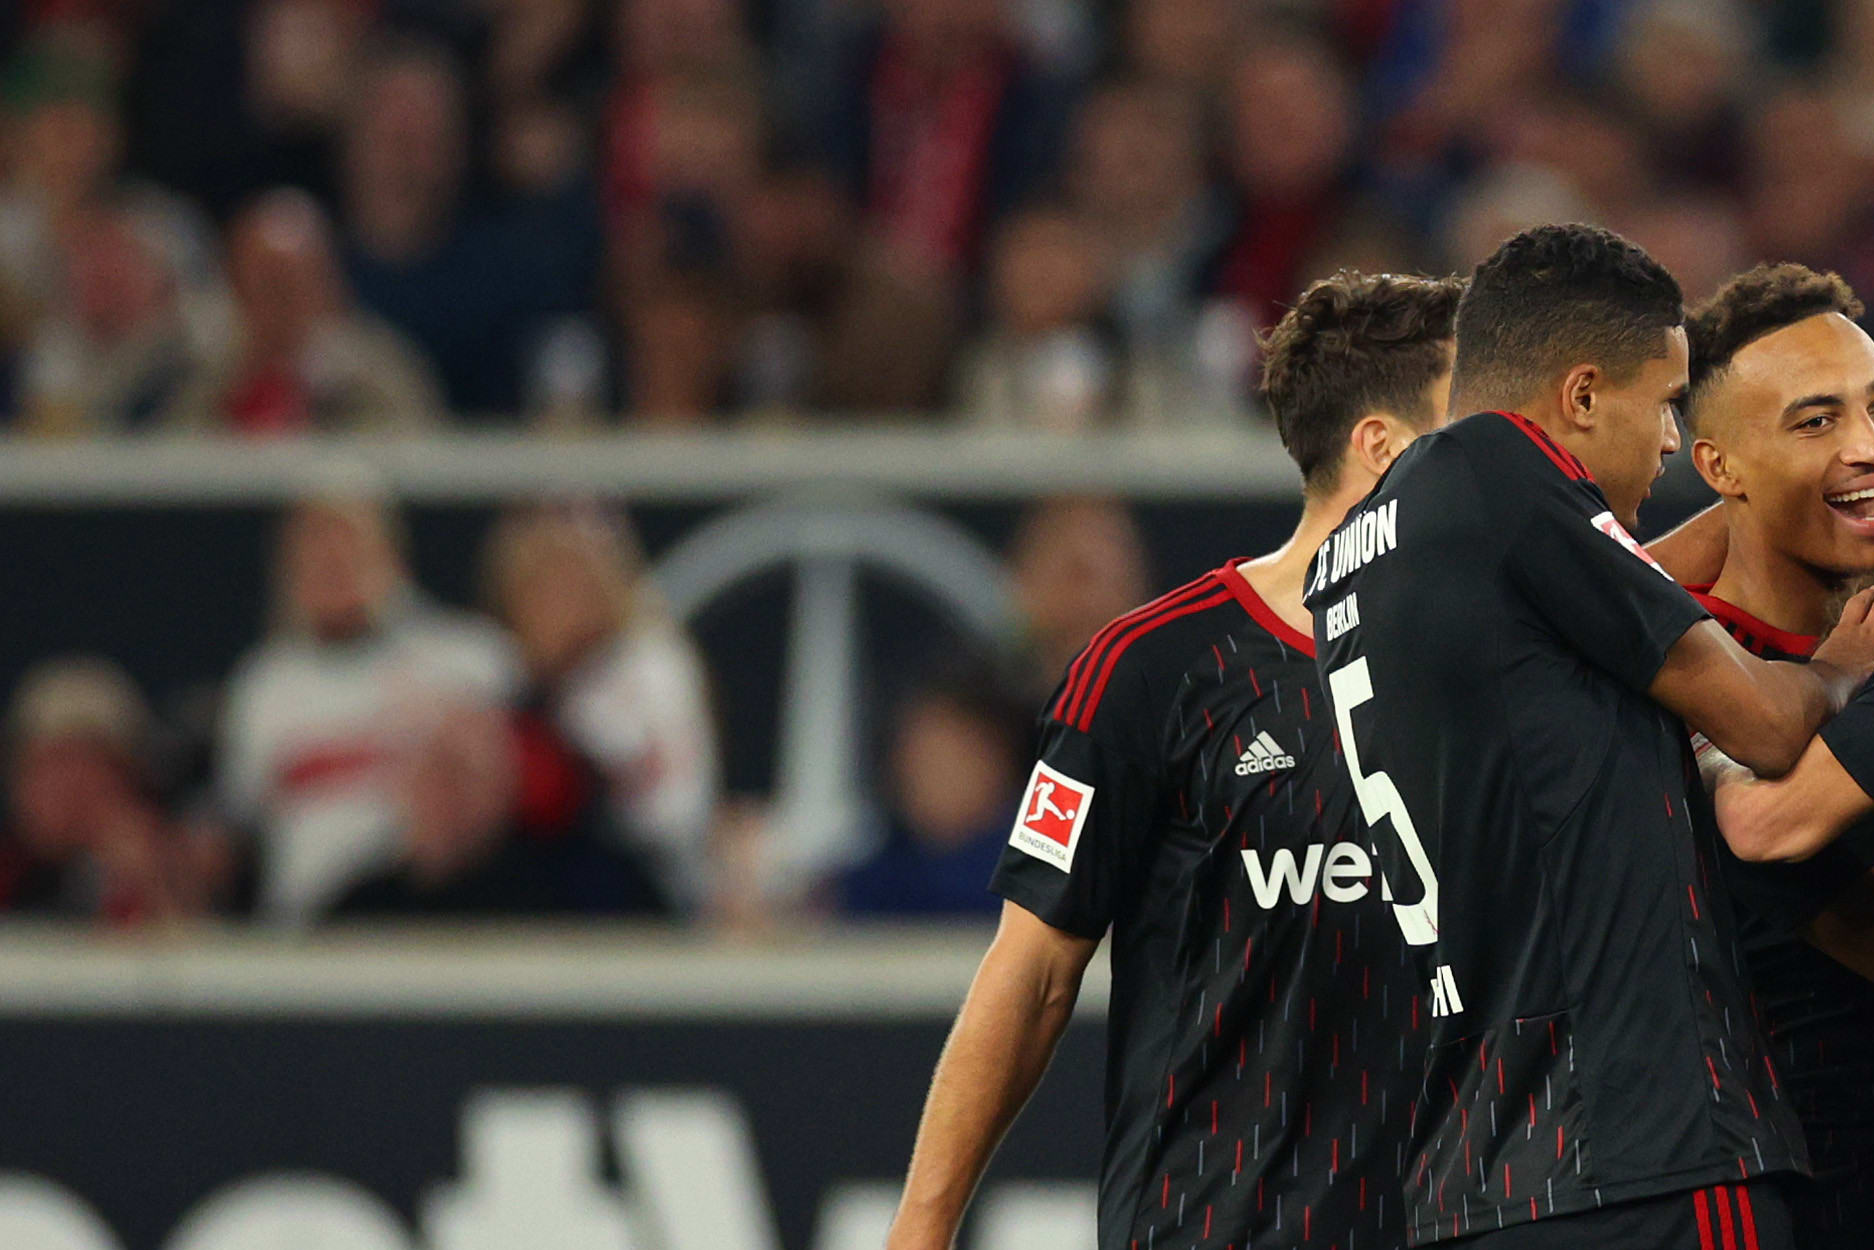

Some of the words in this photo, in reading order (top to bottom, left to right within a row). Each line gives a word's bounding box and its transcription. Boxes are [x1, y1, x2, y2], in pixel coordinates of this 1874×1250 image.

[1331, 499, 1398, 584] UNION
[1326, 592, 1360, 642] BERLIN
[1235, 753, 1296, 777] adidas
[1328, 655, 1439, 946] 5
[1018, 831, 1067, 862] BUNDESLIGA
[1240, 842, 1394, 910] we
